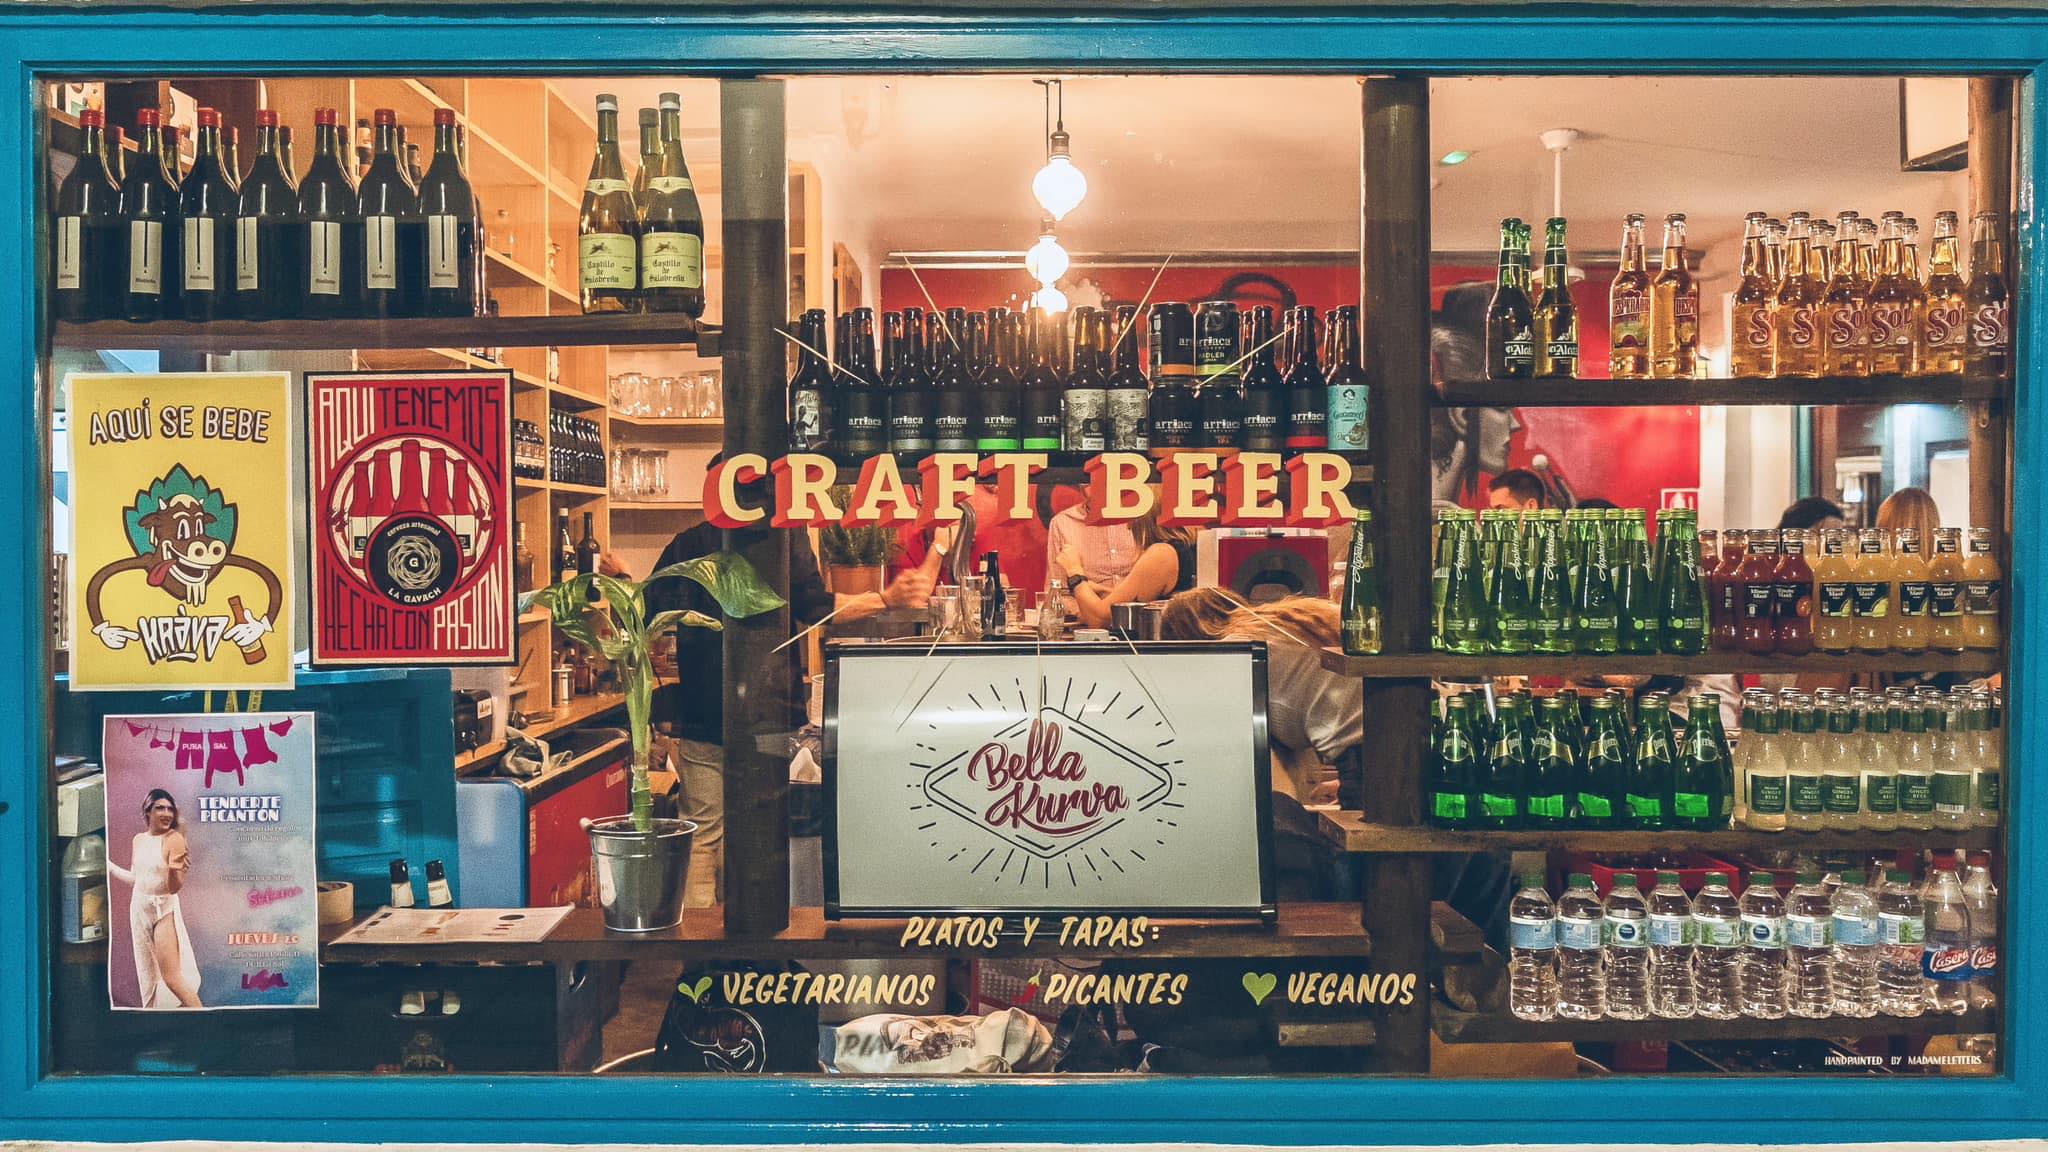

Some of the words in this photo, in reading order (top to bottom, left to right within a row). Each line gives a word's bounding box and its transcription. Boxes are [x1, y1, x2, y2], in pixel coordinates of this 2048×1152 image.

[160, 406, 194, 438] SE
[203, 406, 271, 444] BEBE
[319, 387, 375, 491] AQUI
[378, 386, 500, 488] TENEMOS
[706, 452, 1048, 526] CRAFT
[1086, 452, 1361, 526] BEER
[323, 549, 388, 650] HECHA
[391, 606, 430, 650] CON
[433, 545, 504, 650] PASION
[388, 587, 400, 599] LA
[967, 718, 1087, 791] Bella
[198, 796, 281, 809] TENDERTE
[200, 809, 280, 822] PICANTON
[985, 782, 1130, 838] Kurva
[228, 933, 278, 945] JUEVES
[900, 916, 1003, 949] PLATOS
[1023, 916, 1040, 947] Y
[1059, 915, 1160, 947] TAPAS:
[723, 972, 935, 1006] VEGETARIANOS
[1044, 973, 1188, 1005] PICANTES
[1287, 973, 1416, 1006] VEGANOS
[1825, 1056, 1883, 1065] HANDPAINTED
[1891, 1056, 1902, 1065] BY
[1908, 1056, 1982, 1065] MADAMELETTERS
